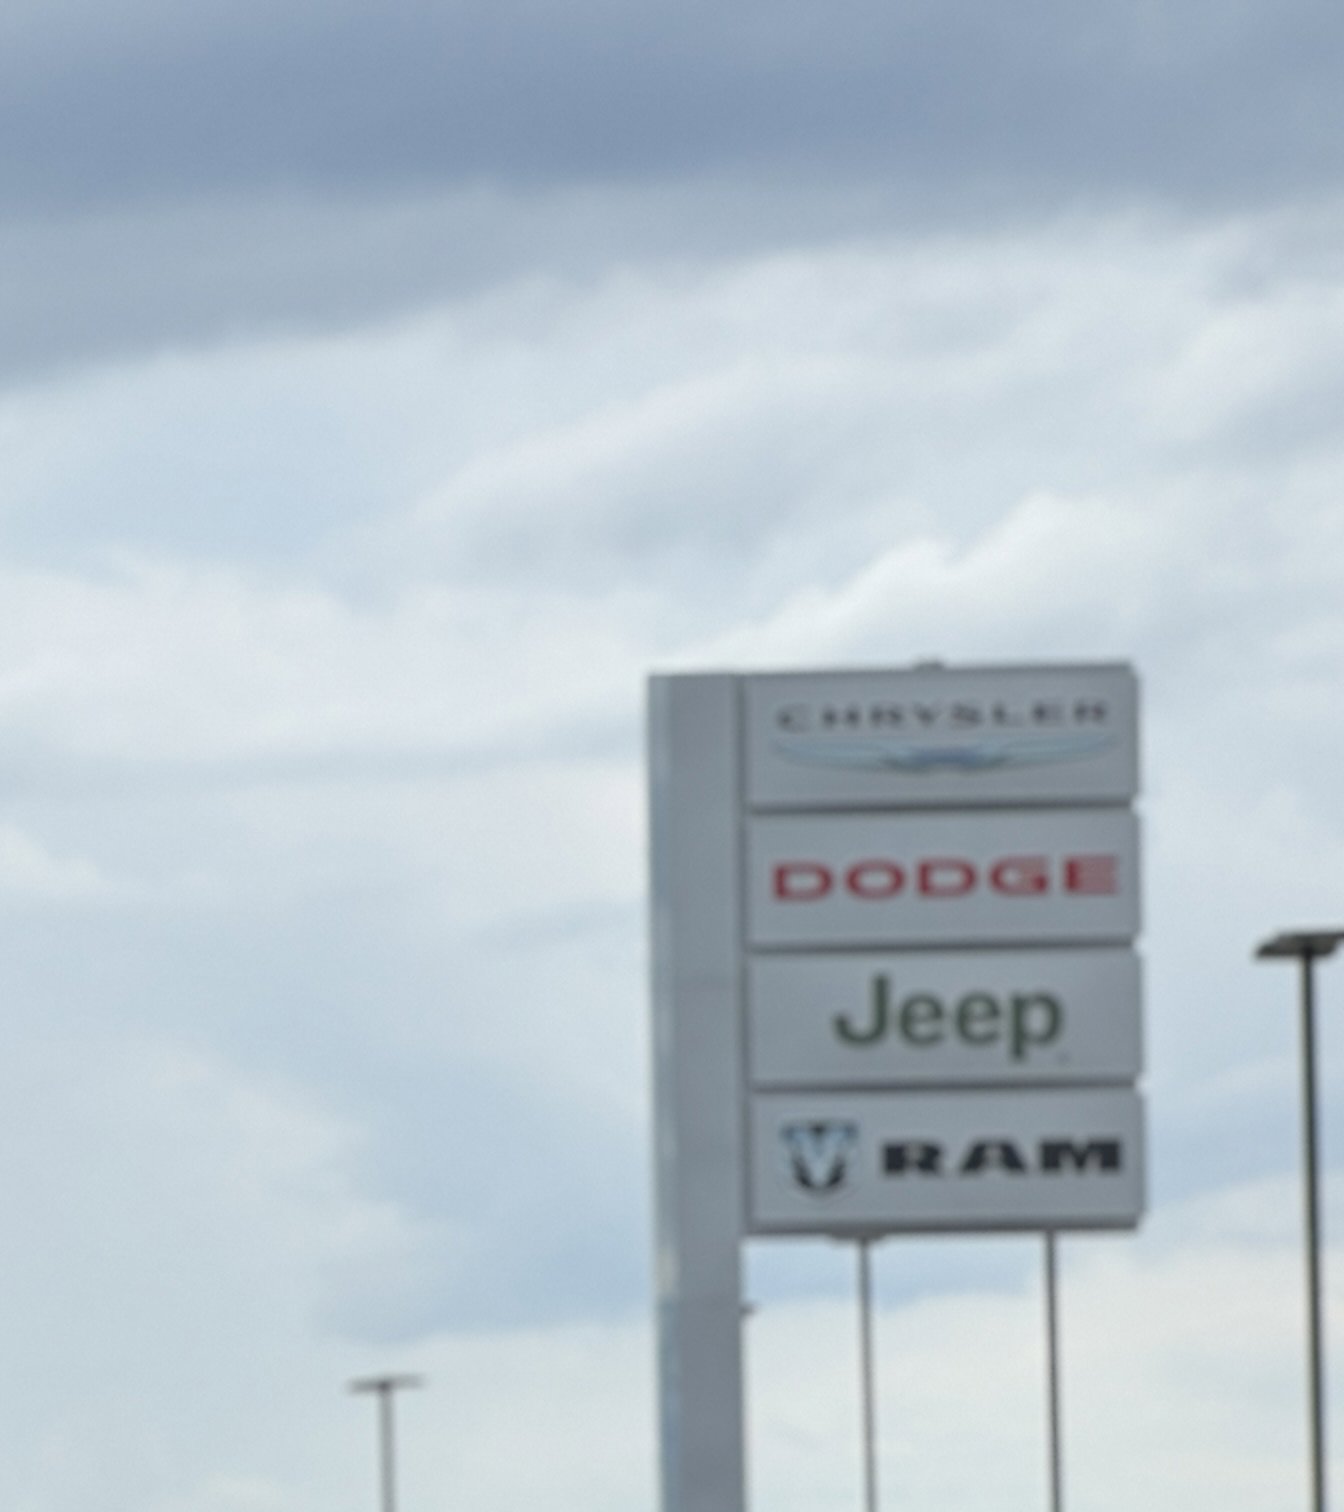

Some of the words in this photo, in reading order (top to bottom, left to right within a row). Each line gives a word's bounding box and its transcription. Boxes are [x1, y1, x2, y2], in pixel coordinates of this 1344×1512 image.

[773, 699, 1110, 733] CHRYSLER
[771, 854, 1120, 902] DODGE
[832, 972, 1064, 1062] Jeep
[880, 1137, 1124, 1178] RAM
